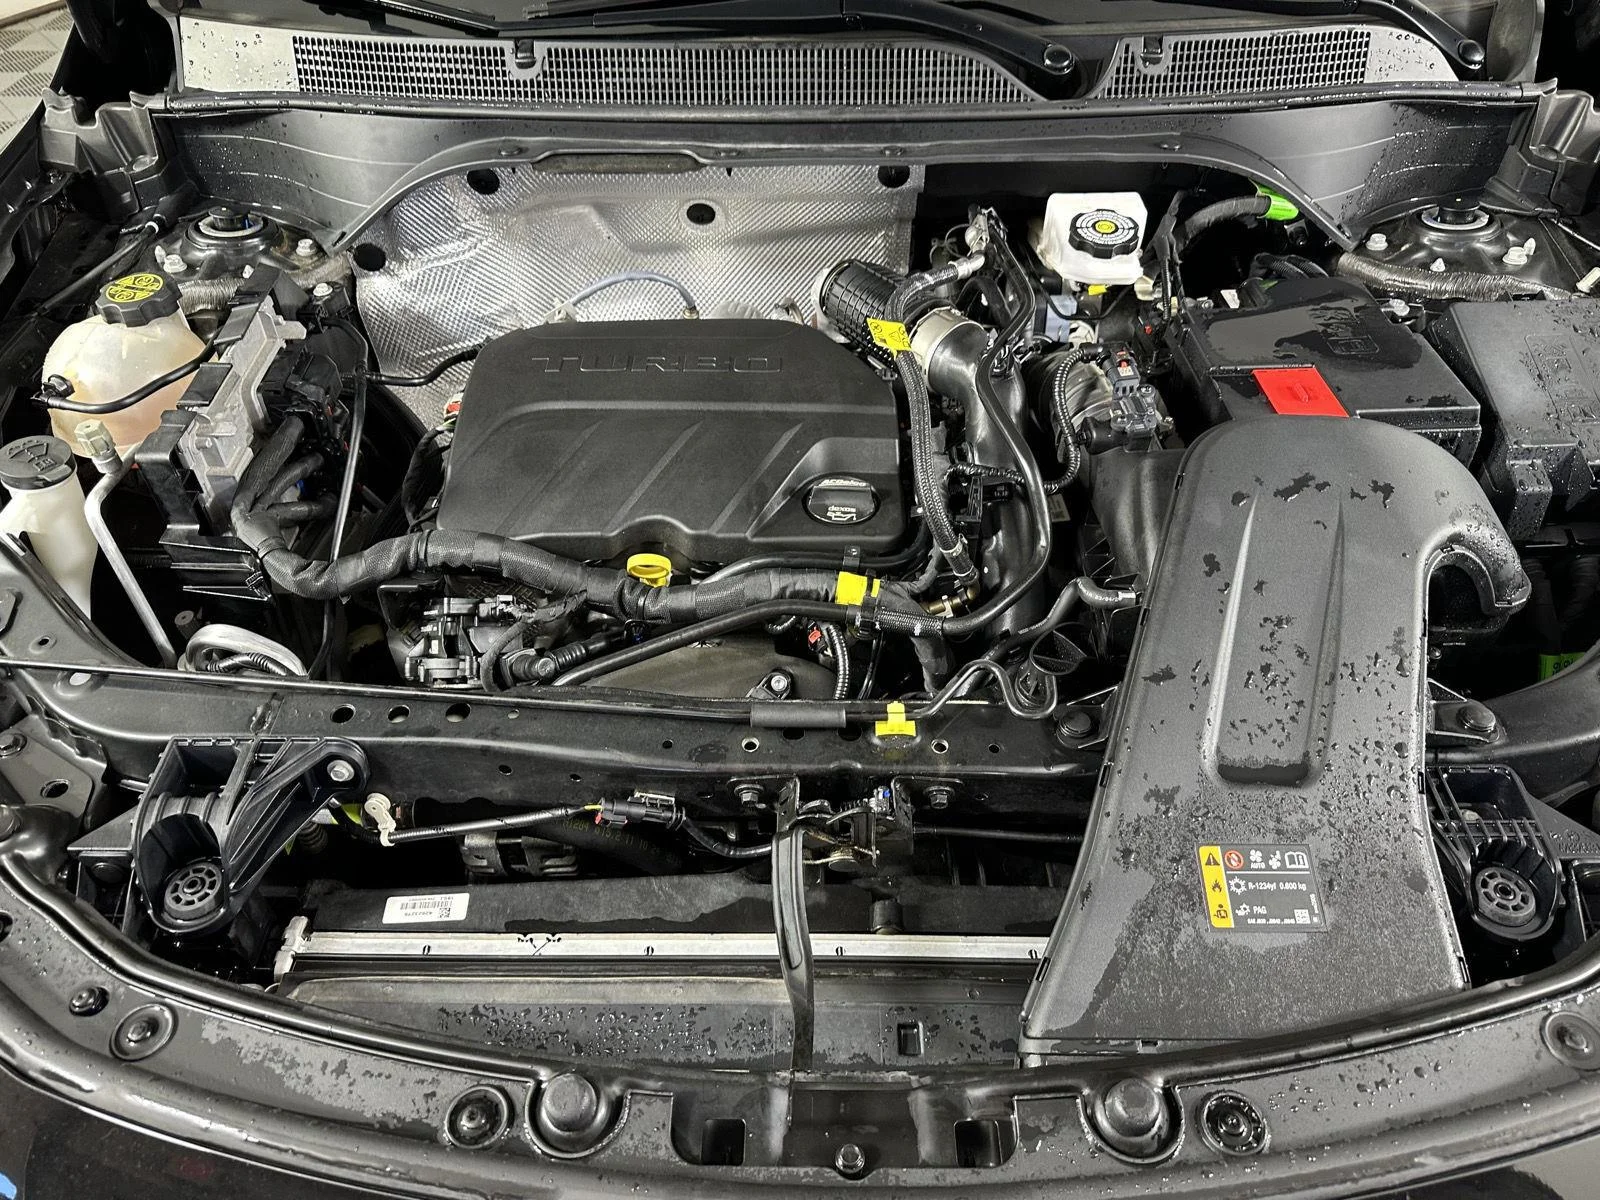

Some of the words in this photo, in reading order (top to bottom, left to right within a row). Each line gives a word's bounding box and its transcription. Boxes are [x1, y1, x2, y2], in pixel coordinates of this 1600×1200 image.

[531, 355, 782, 373] TURBO
[828, 505, 857, 513] dexos
[1298, 882, 1307, 891] kg
[1252, 906, 1267, 914] PAG
